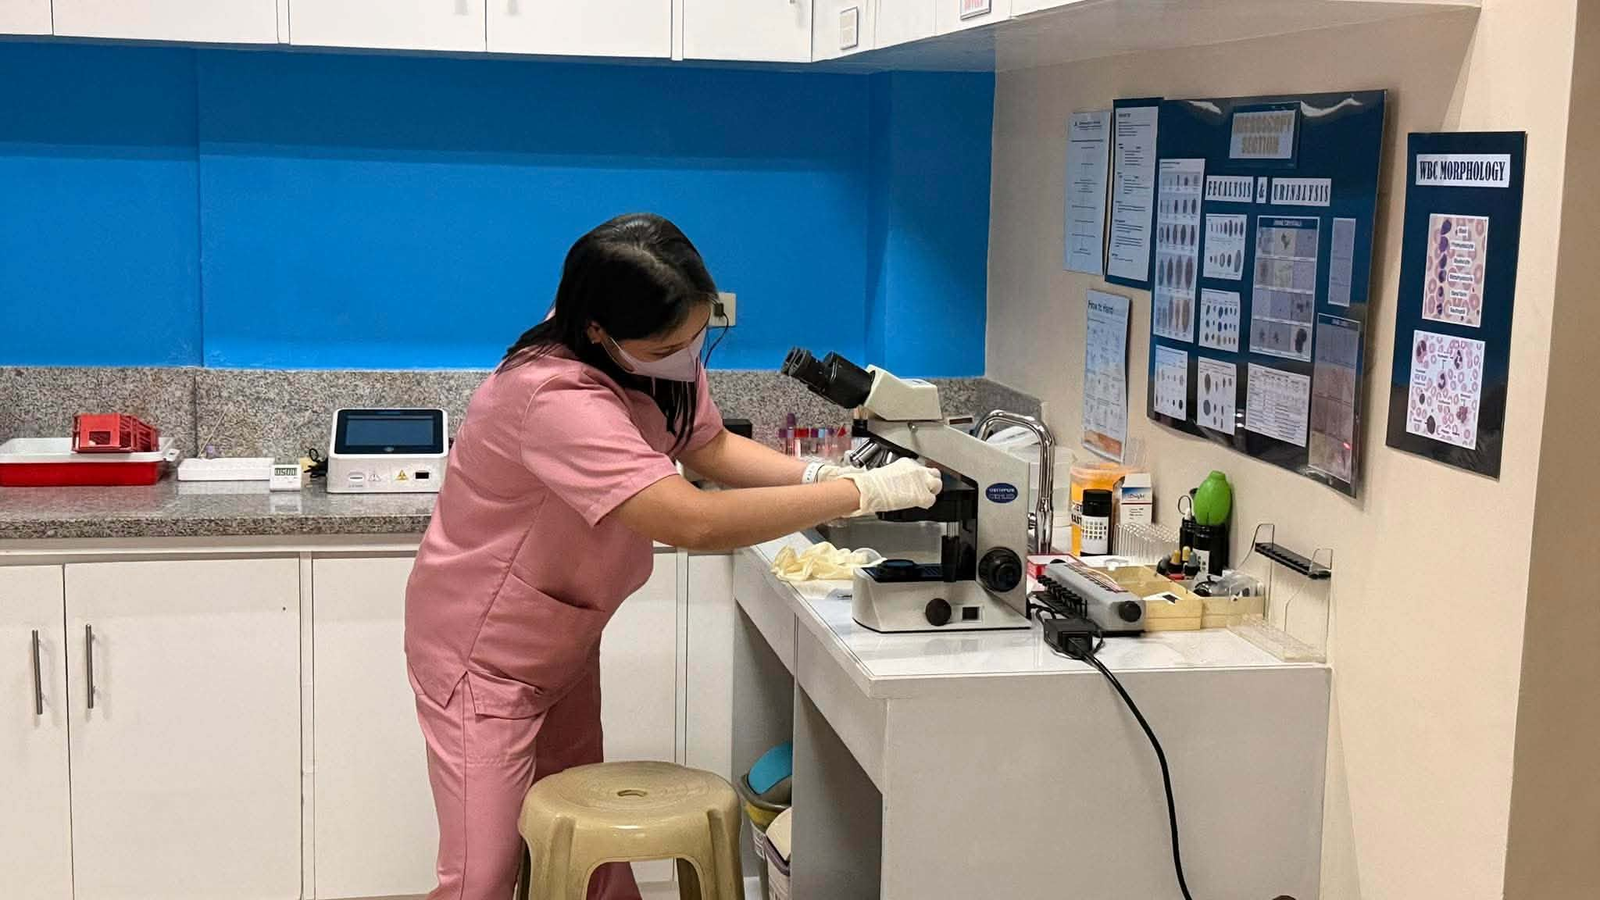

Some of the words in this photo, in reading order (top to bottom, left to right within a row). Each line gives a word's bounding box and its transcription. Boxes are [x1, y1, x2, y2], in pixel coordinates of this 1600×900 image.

[1419, 160, 1438, 180] WBC
[1440, 161, 1506, 181] MORPHOLOGY
[1207, 180, 1251, 198] FECALYSIS
[1258, 182, 1265, 198] &
[1273, 183, 1329, 202] URINALYSIS
